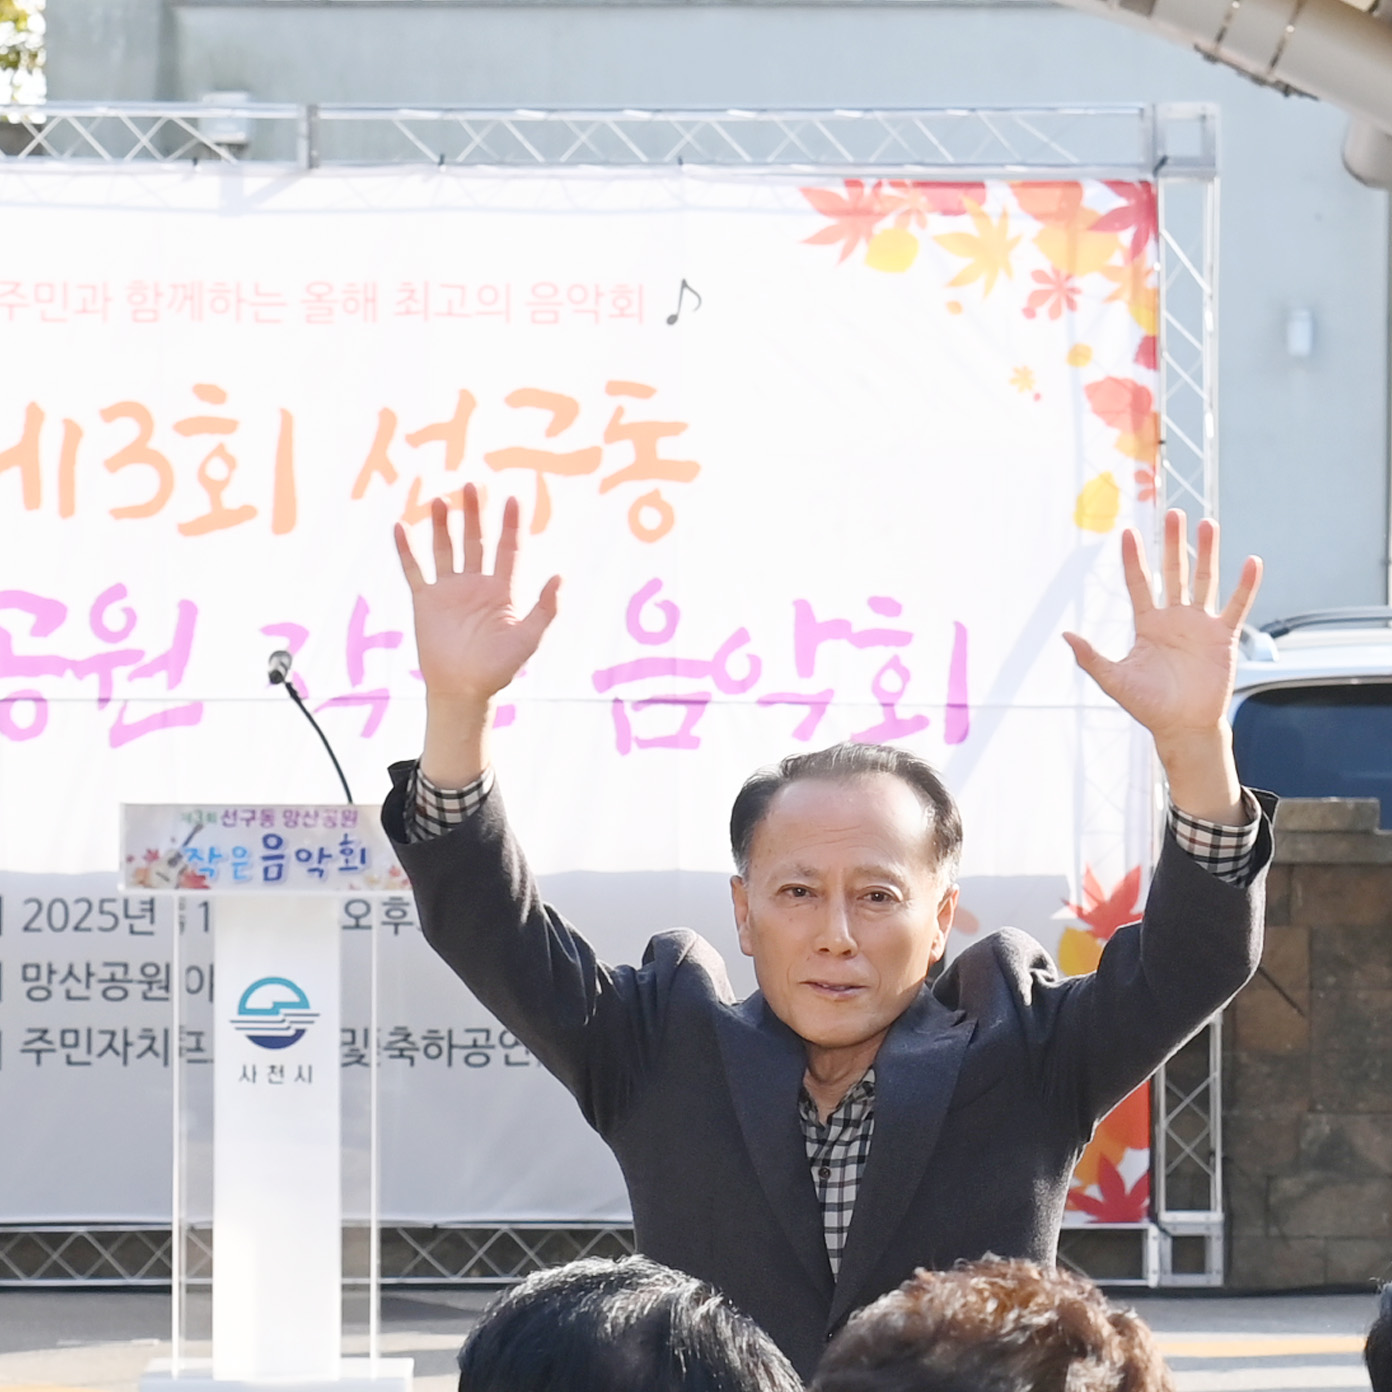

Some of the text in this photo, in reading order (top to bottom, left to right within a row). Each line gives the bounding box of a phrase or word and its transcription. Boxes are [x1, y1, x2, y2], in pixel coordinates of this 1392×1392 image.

[127, 279, 287, 324] 함께하는
[299, 281, 379, 324] 올해
[394, 282, 512, 325] 최고의
[524, 282, 646, 325] 음악회
[351, 380, 701, 543] 선구동
[260, 594, 528, 740] 작
[592, 577, 970, 755] 음악회
[221, 808, 276, 828] 선구동
[282, 808, 359, 828] 망산공원
[22, 897, 156, 935] 2025년
[21, 962, 171, 1002] 망산공원
[20, 1027, 170, 1068] 주민자치
[238, 1064, 314, 1086] 사천시
